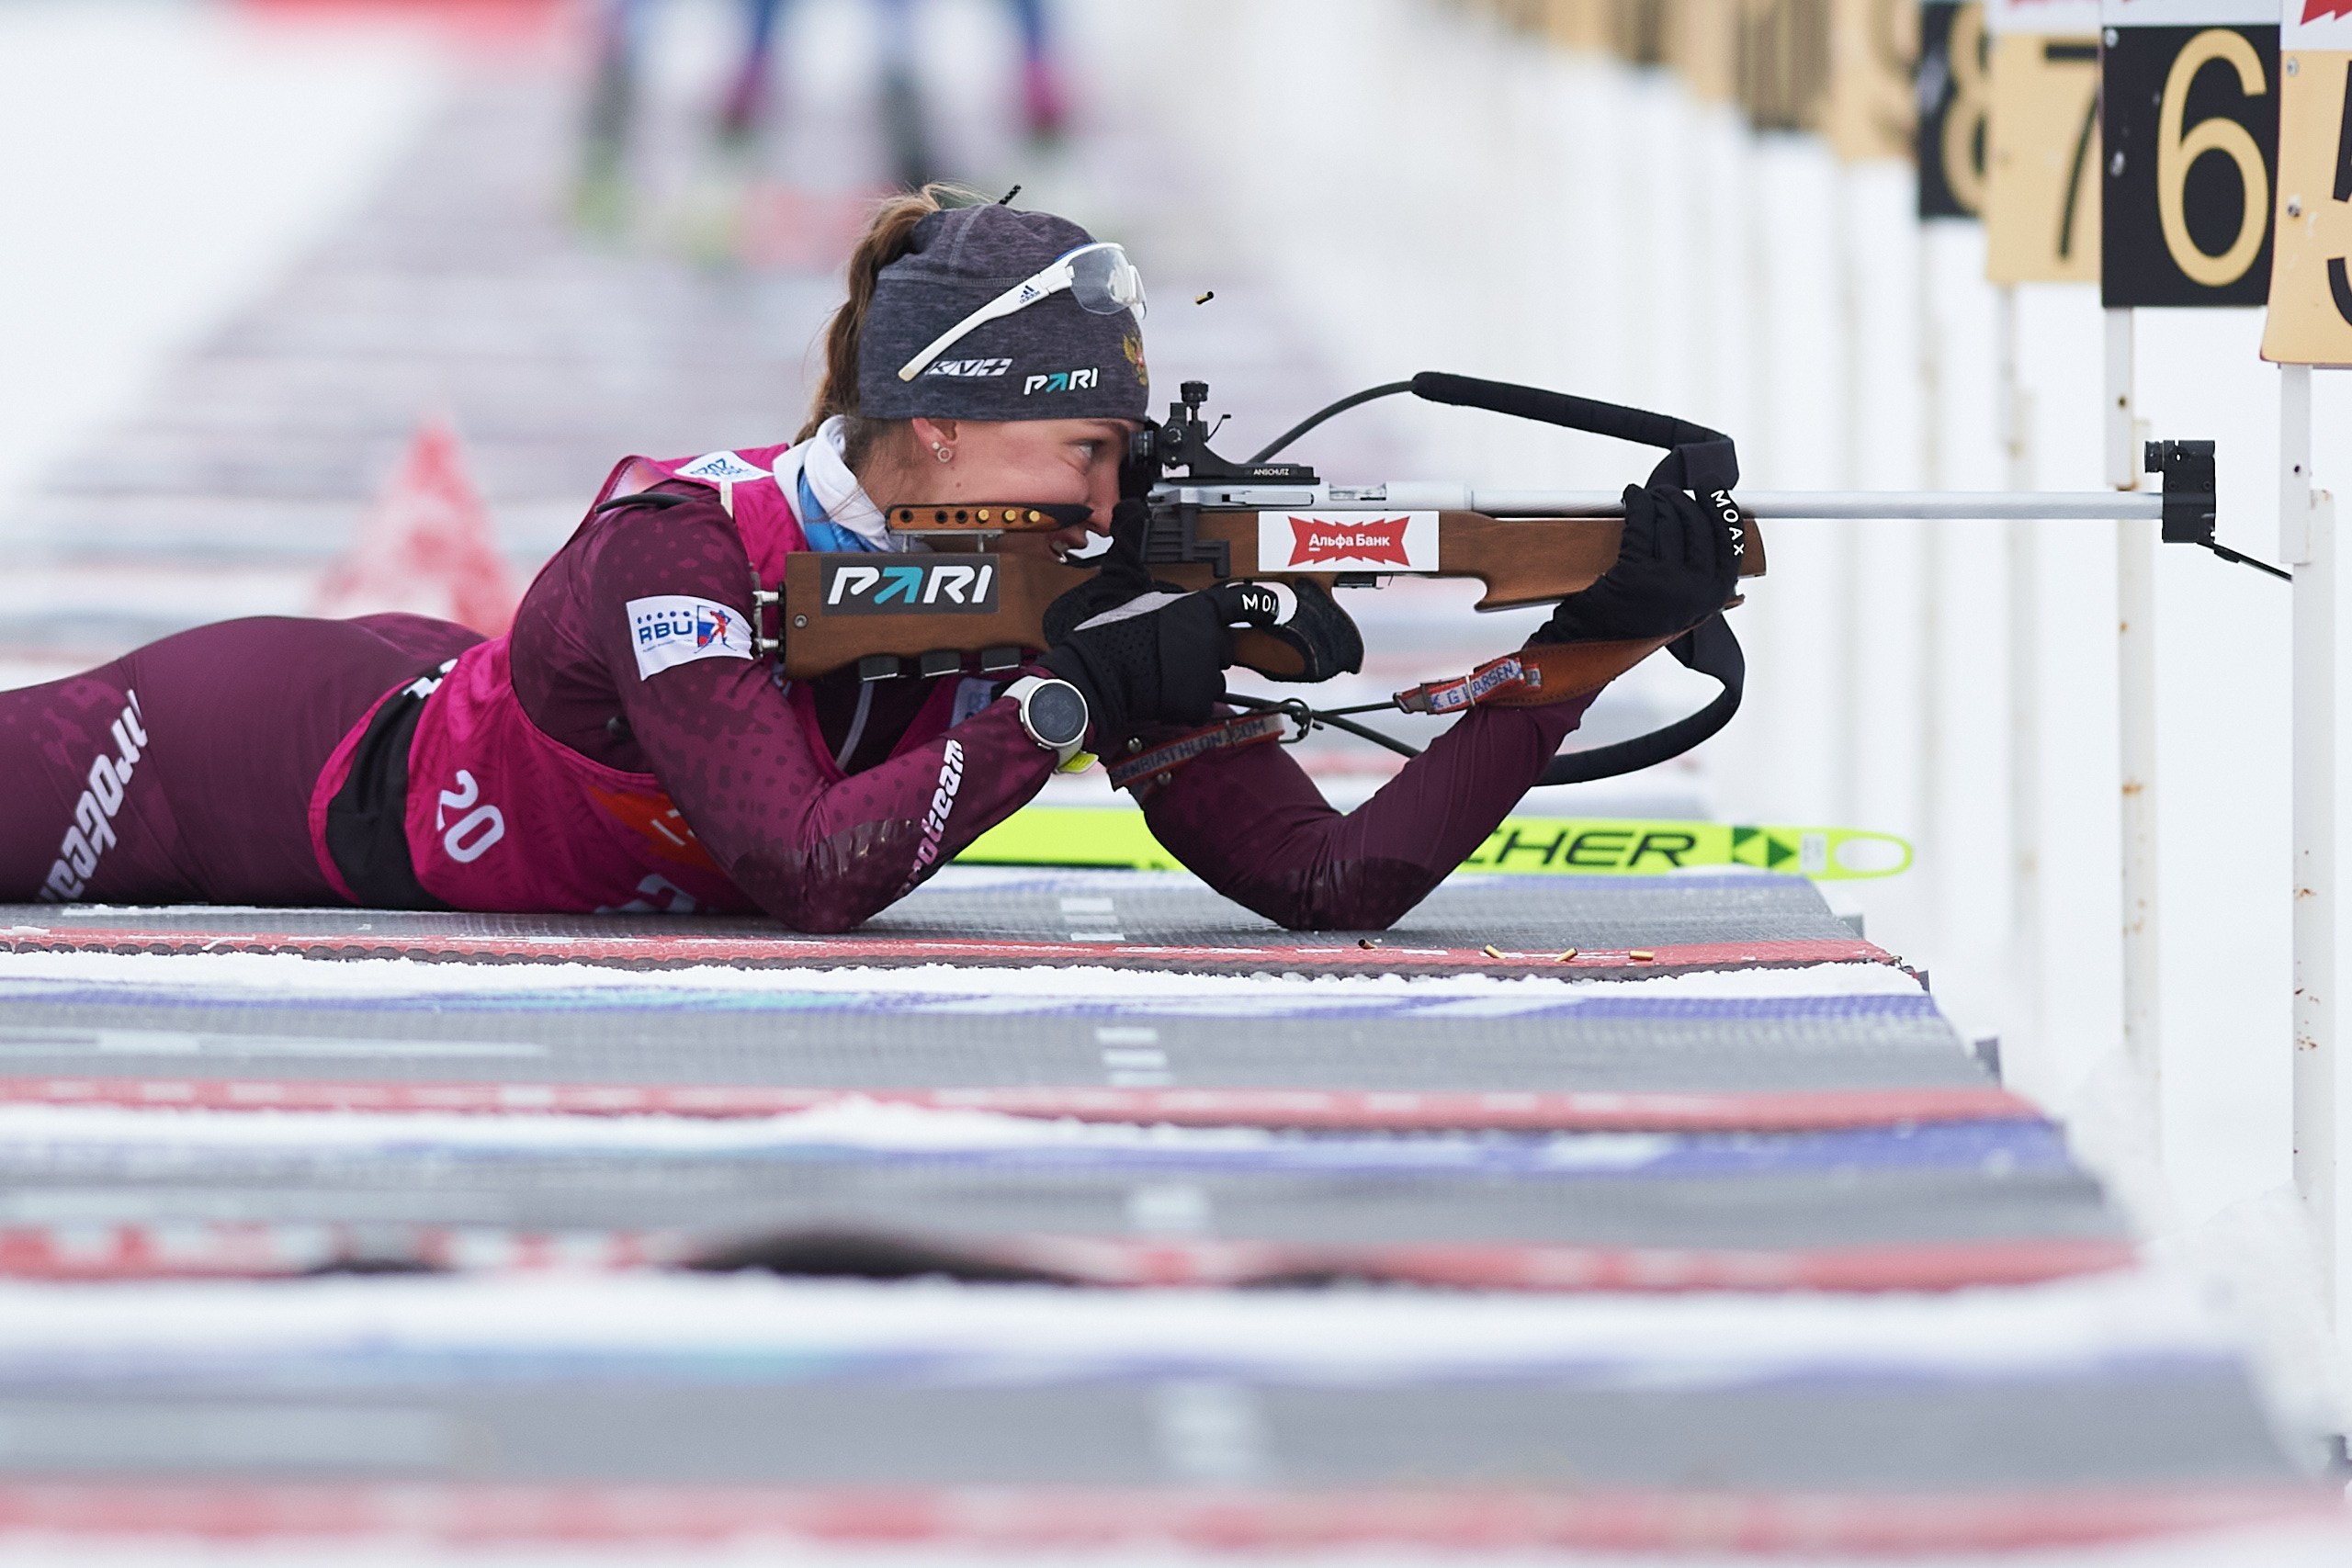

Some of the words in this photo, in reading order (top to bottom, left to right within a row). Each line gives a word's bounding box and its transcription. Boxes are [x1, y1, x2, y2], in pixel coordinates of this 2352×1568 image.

[2042, 42, 2101, 263] 7
[2157, 28, 2269, 288] 6
[1023, 367, 1100, 396] PARI
[1308, 533, 1354, 551] Альфа
[1355, 533, 1390, 547] Банк
[1710, 489, 1745, 557] MOAX
[827, 564, 993, 605] PARI
[639, 620, 693, 645] RBU
[40, 688, 149, 902] rotea
[435, 768, 505, 863] 20
[900, 739, 965, 889] roteam
